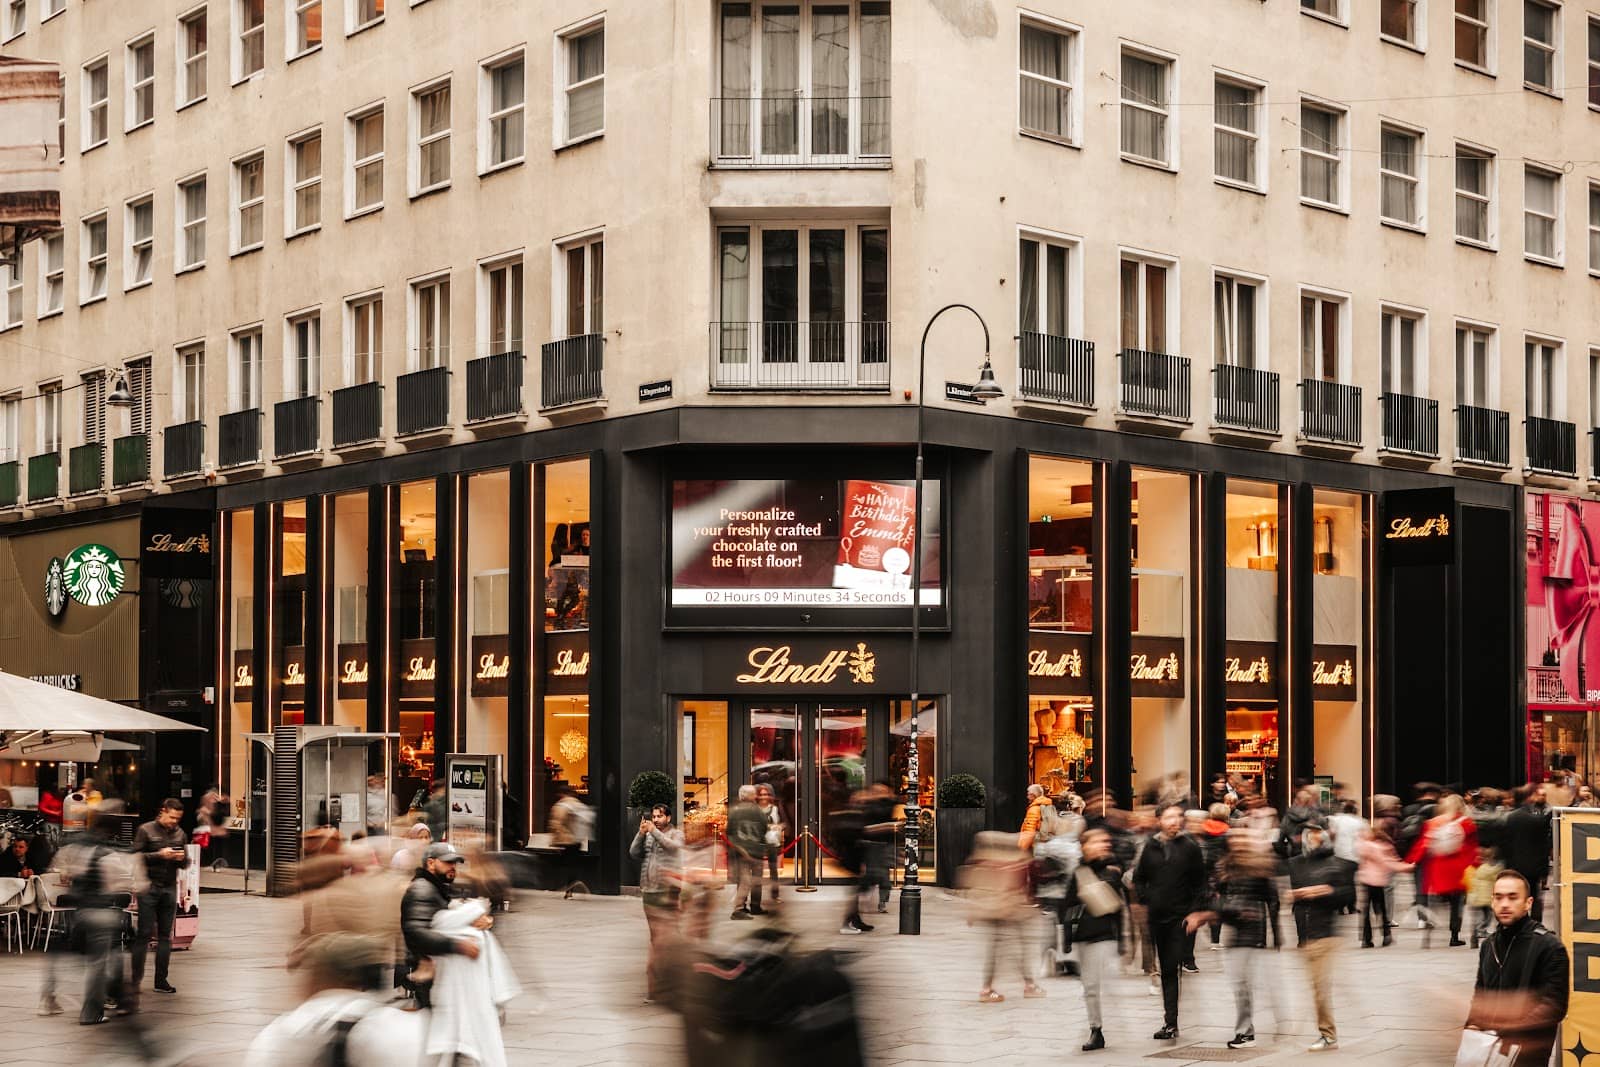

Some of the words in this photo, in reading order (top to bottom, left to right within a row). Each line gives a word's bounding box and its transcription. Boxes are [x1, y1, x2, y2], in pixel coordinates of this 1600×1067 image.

[866, 493, 904, 509] HAPPY
[720, 507, 795, 521] Personalize
[849, 505, 909, 530] Birthday
[693, 526, 723, 539] your
[727, 523, 771, 539] freshly
[774, 523, 821, 536] crafted
[849, 520, 905, 541] Emma
[1386, 517, 1436, 539] Lindt
[146, 533, 198, 552] Lindt
[712, 538, 777, 552] chocolate
[780, 542, 798, 552] on
[712, 554, 733, 568] the
[736, 554, 763, 568] first
[766, 554, 802, 568] floor!
[705, 591, 720, 602] 02
[724, 591, 760, 602] Hours
[764, 591, 779, 602] 09
[783, 591, 832, 602] Minutes
[836, 591, 850, 602] 34
[854, 591, 906, 602] Seconds
[342, 659, 368, 683] Lind
[407, 656, 436, 681] Lind
[736, 646, 849, 683] Lindt
[1028, 649, 1071, 677] Lindt
[1131, 654, 1169, 680] Lindt
[452, 770, 463, 784] WC
